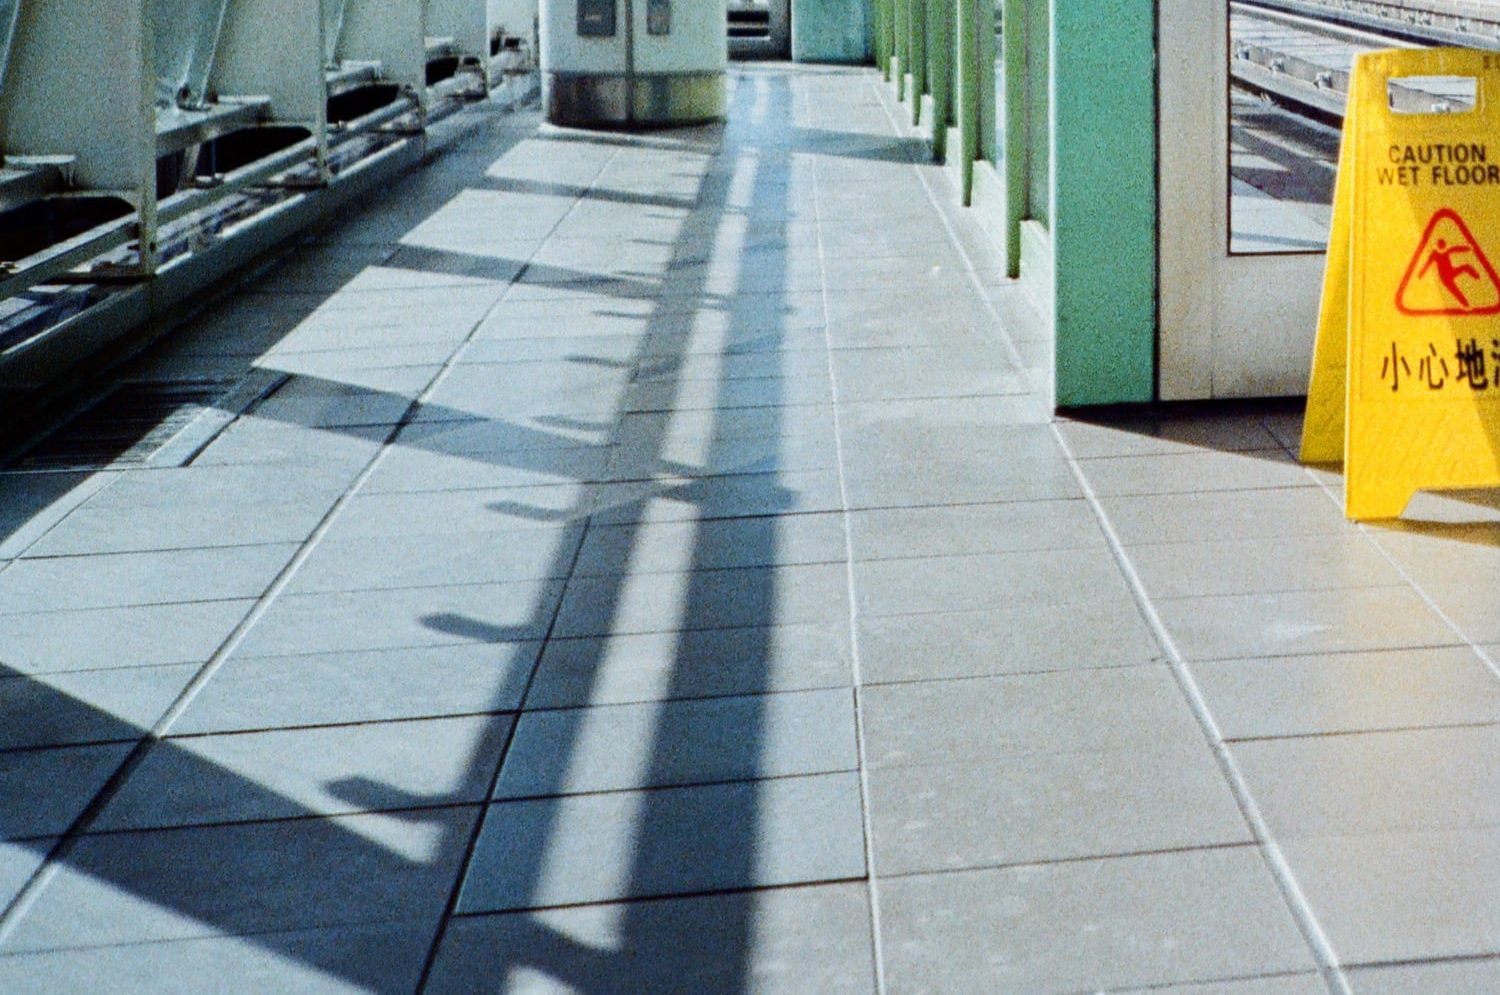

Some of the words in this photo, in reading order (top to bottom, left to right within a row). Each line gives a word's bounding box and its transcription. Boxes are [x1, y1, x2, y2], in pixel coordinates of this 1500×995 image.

[1388, 143, 1487, 164] CAUTION
[1376, 166, 1419, 186] WET
[1432, 164, 1500, 186] FLOOR
